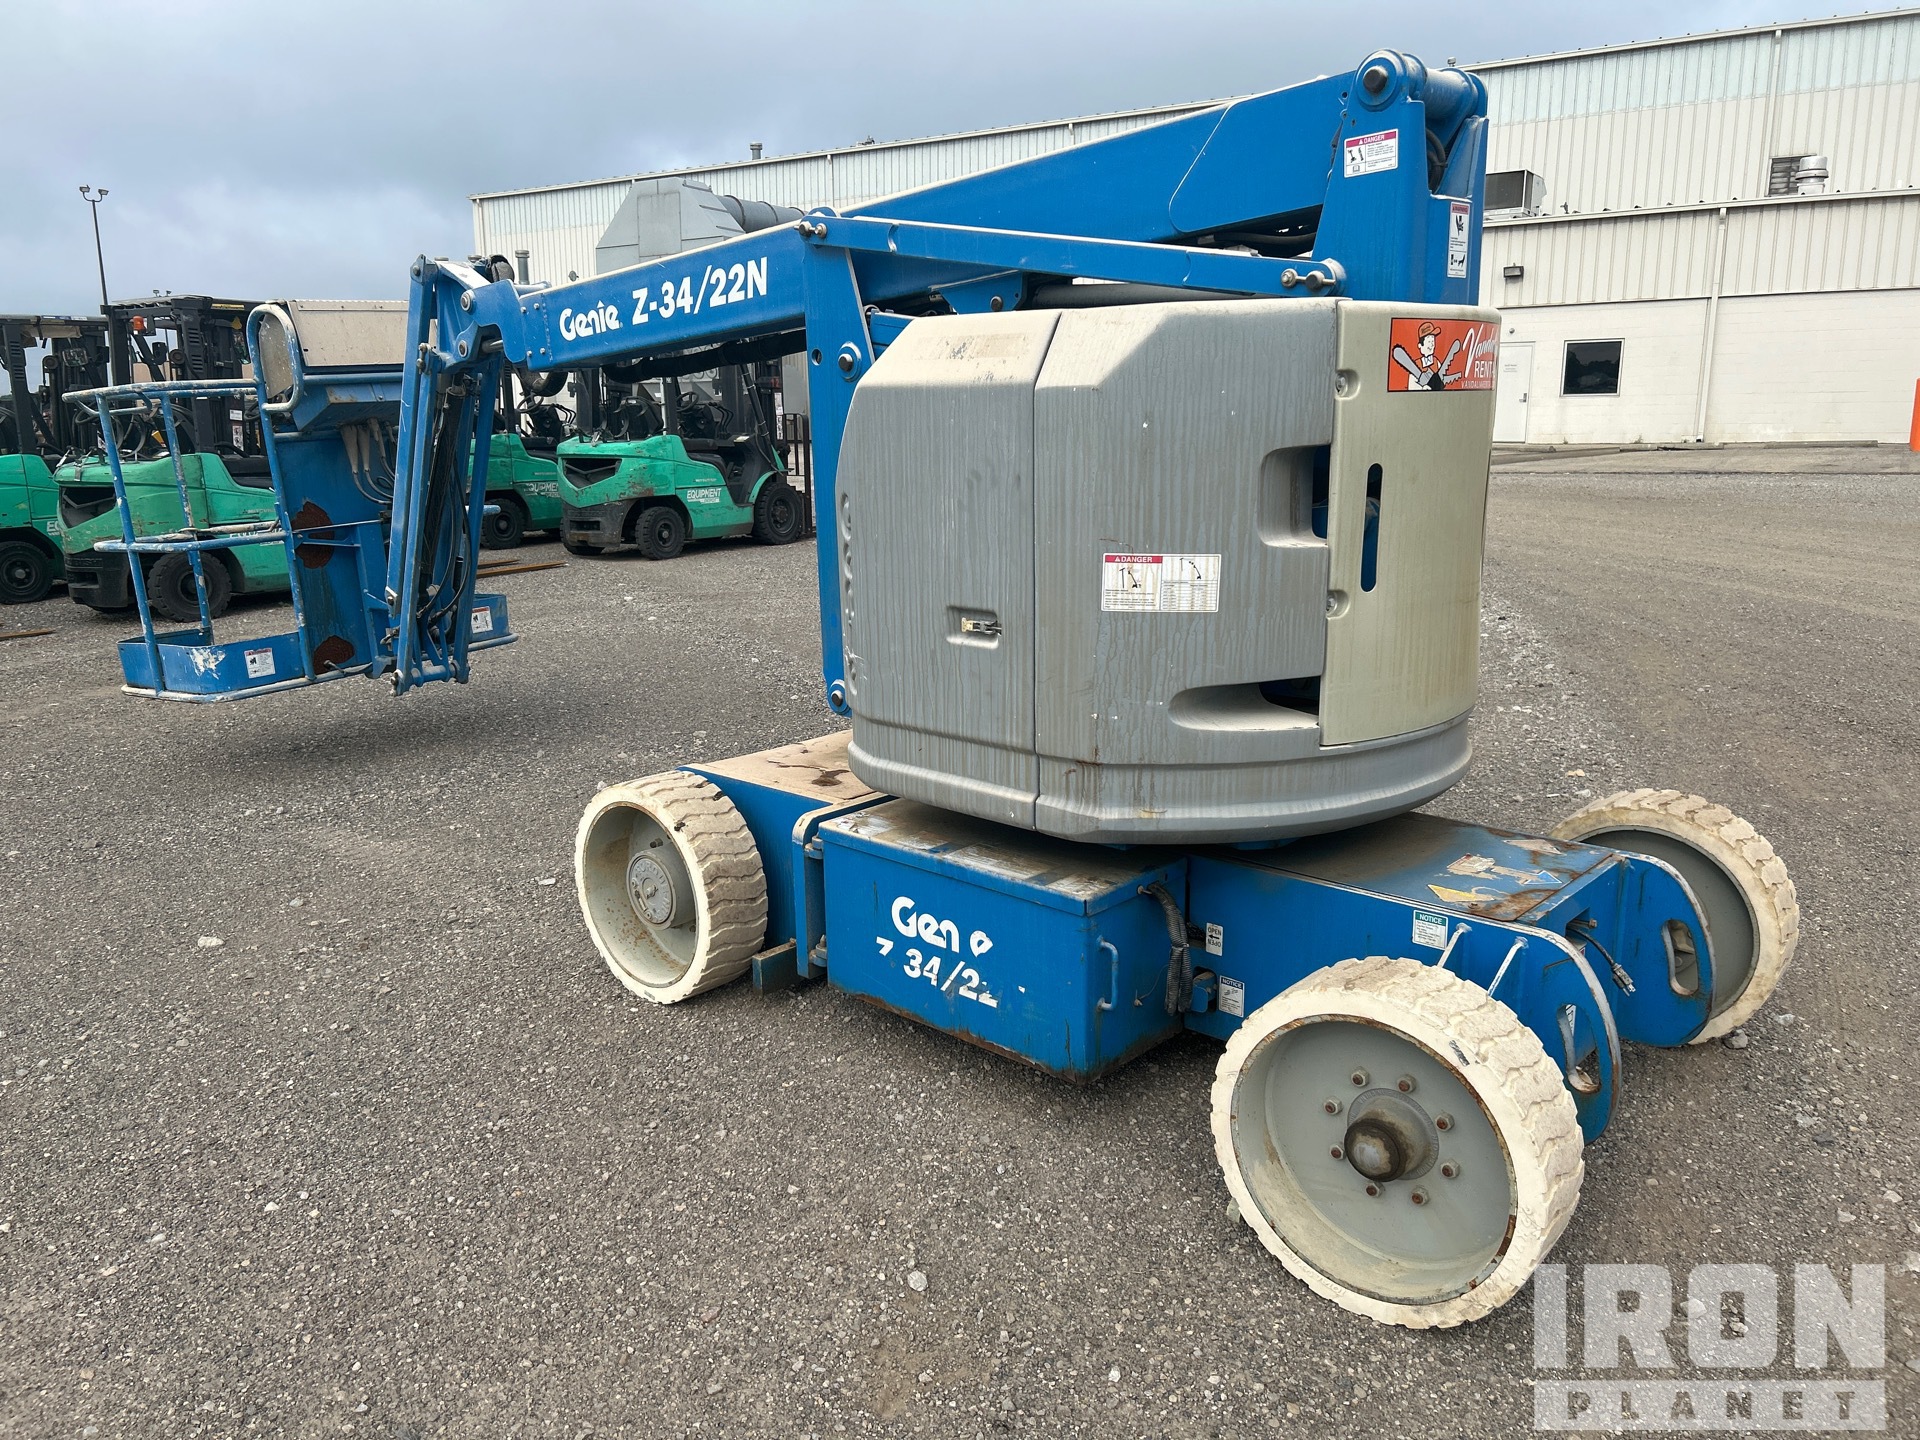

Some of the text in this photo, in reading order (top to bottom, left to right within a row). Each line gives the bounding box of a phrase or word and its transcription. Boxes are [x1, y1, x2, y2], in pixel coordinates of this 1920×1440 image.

[1363, 134, 1385, 144] DANGER
[559, 257, 768, 342] Genie Z-34/22N
[687, 488, 722, 499] EQUIPMENT
[1419, 913, 1443, 925] NOTICE
[891, 896, 994, 958] Gene
[1208, 926, 1222, 936] OPEN
[1222, 978, 1242, 989] NOTICE
